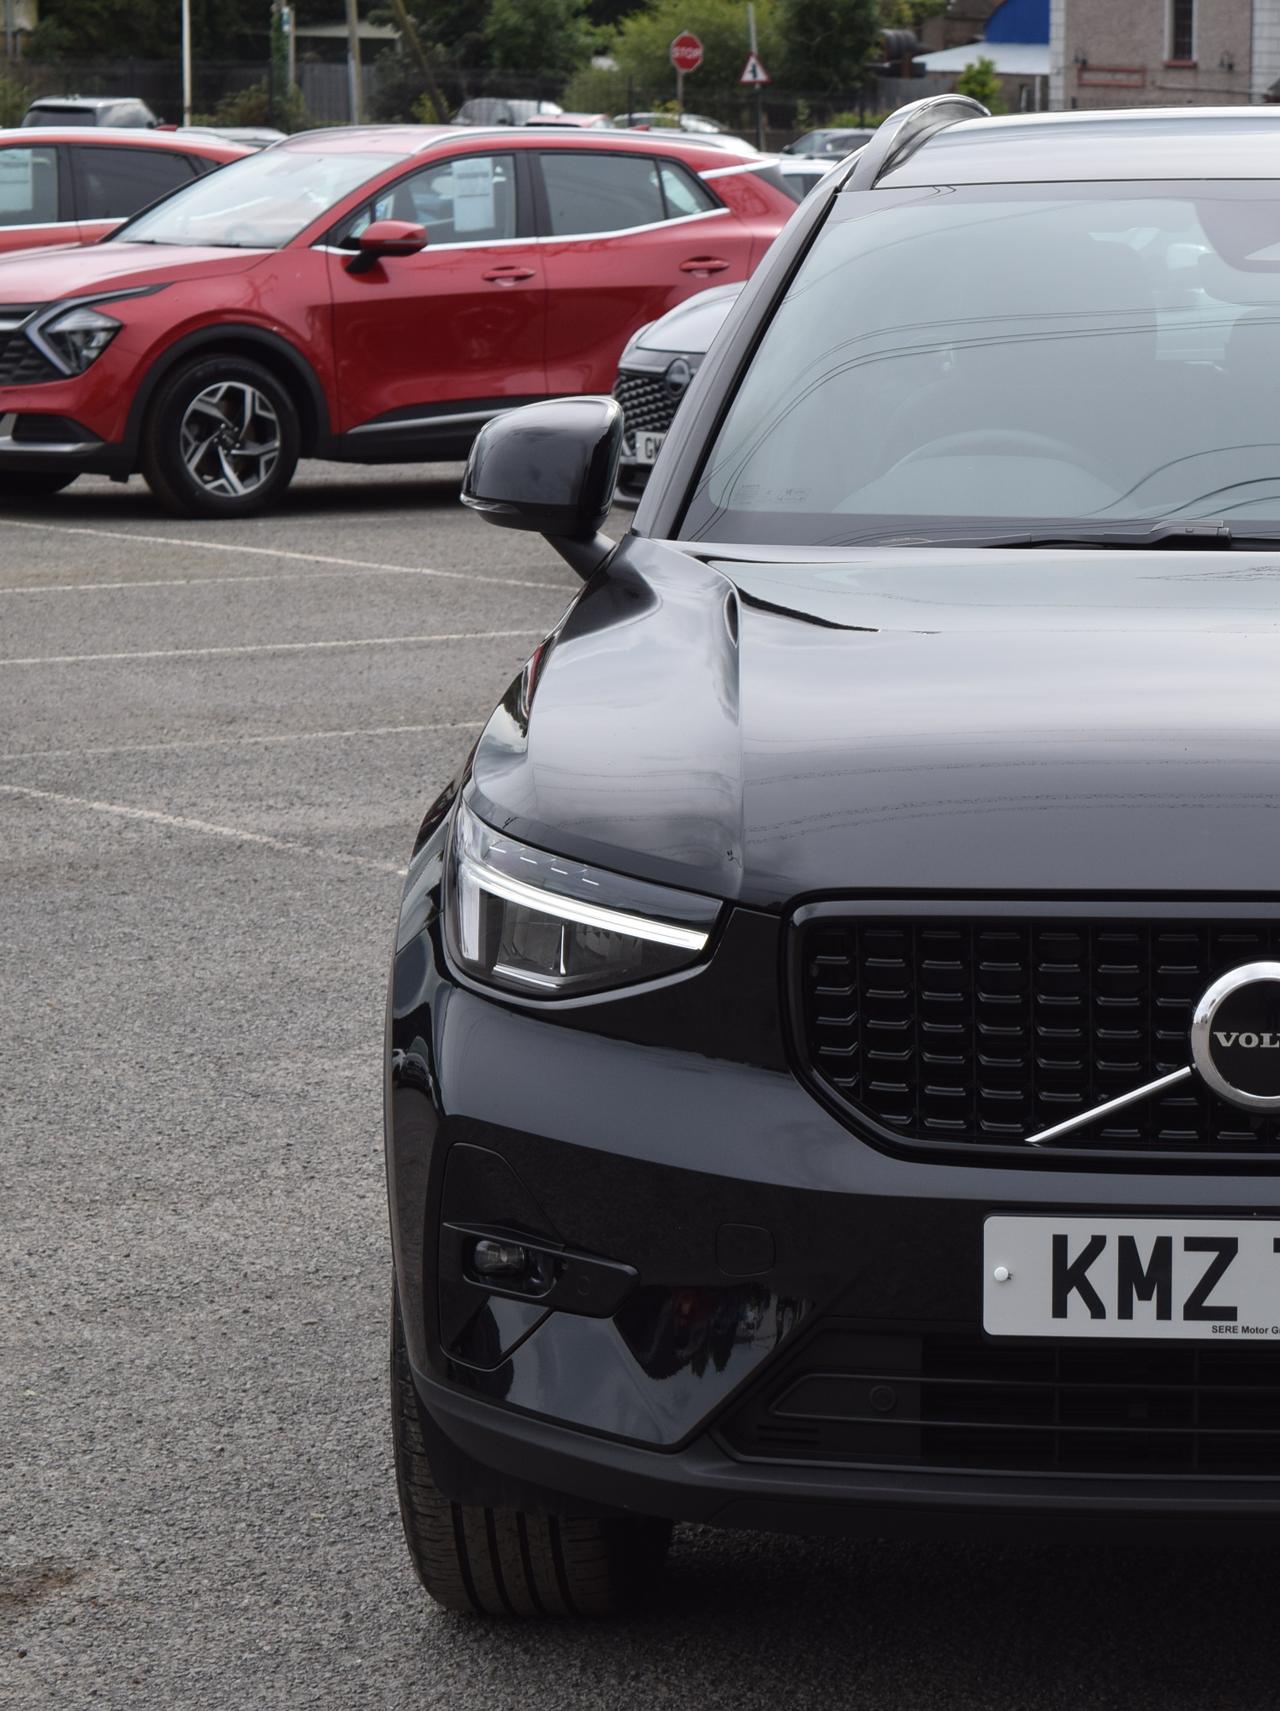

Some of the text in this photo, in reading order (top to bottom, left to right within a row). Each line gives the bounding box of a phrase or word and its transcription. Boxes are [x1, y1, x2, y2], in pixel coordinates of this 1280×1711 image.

[672, 46, 703, 59] STOP
[1051, 1233, 1239, 1322] KMZ
[1211, 1325, 1239, 1334] SERE
[1241, 1325, 1269, 1335] Motor
